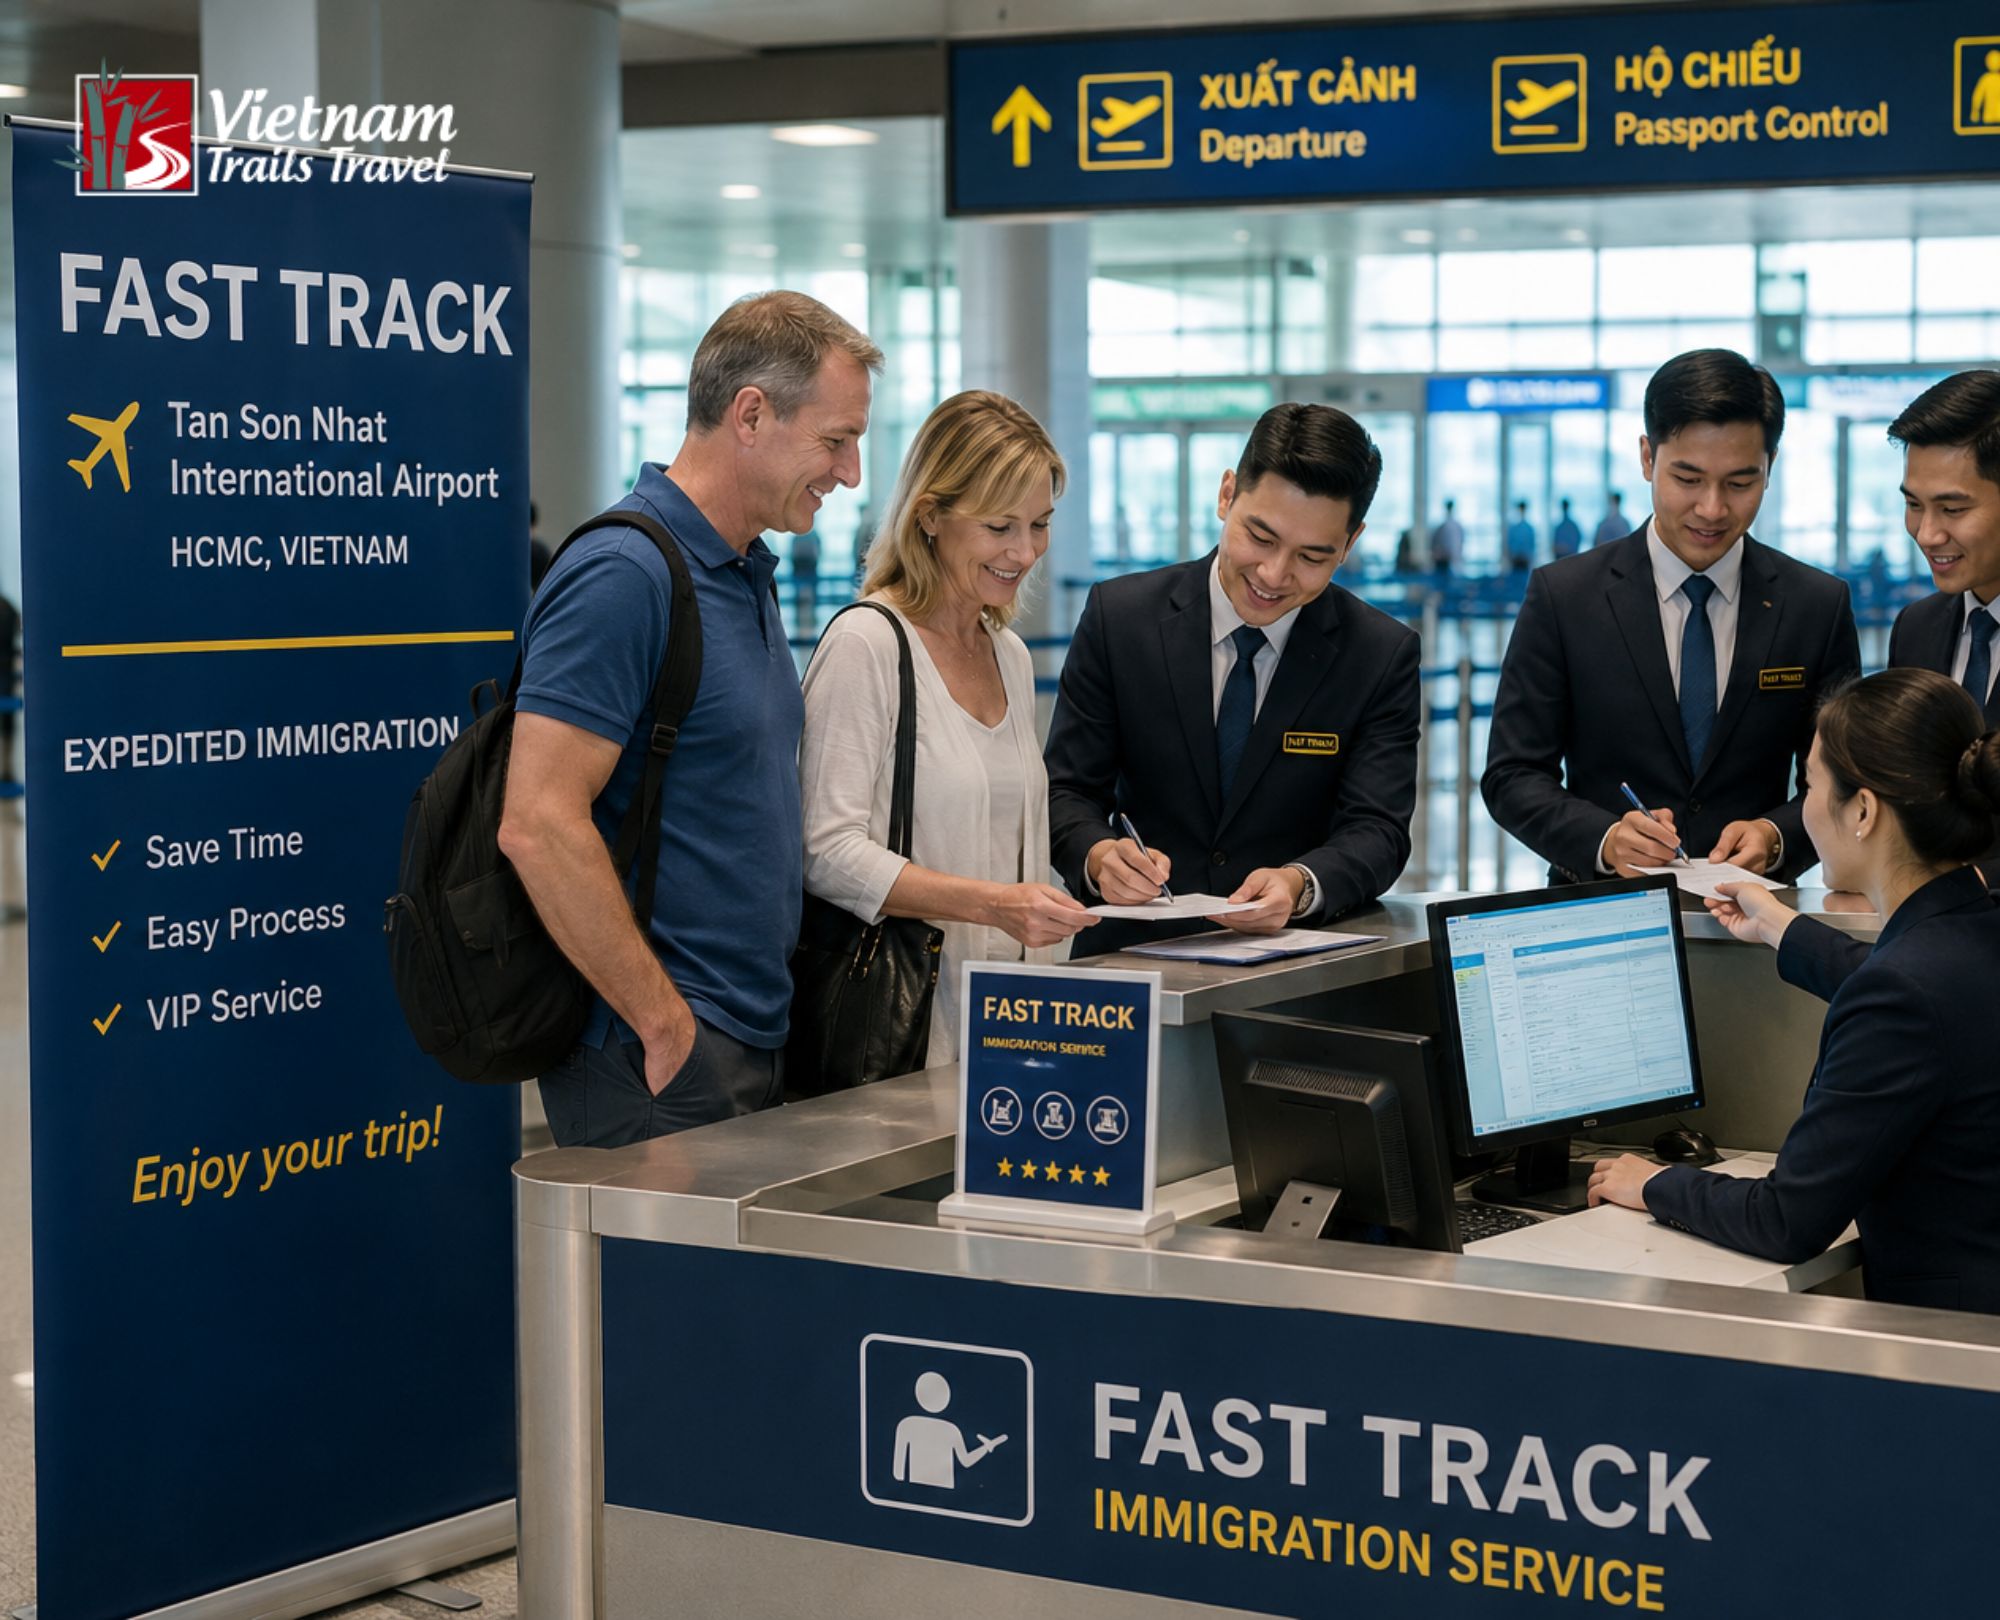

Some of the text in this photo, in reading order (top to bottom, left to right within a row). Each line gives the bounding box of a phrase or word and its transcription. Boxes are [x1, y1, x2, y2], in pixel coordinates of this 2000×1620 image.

[1200, 57, 1416, 109] XUẤT CẢNH
[1616, 35, 1800, 97] HỘ CHIẾU
[1200, 128, 1366, 167] Departure
[1616, 102, 1887, 150] Passport Control
[61, 252, 512, 355] FAST TRACK
[168, 402, 387, 442] Tan Son Nhat
[172, 459, 498, 506] International Airport
[172, 536, 407, 571] HCMC, VIETNAM
[65, 716, 458, 772] EXPEDITED IMMIGRATION
[147, 827, 302, 868] Save Time
[149, 904, 345, 952] Easy Process
[147, 980, 321, 1030] VIP Service
[984, 997, 1134, 1029] FAST TRACK
[133, 1105, 442, 1206] Enjoy your trip!
[1095, 1383, 1712, 1541] FAST TRACK
[1095, 1487, 1665, 1612] IMMIGRATION SERVICE
